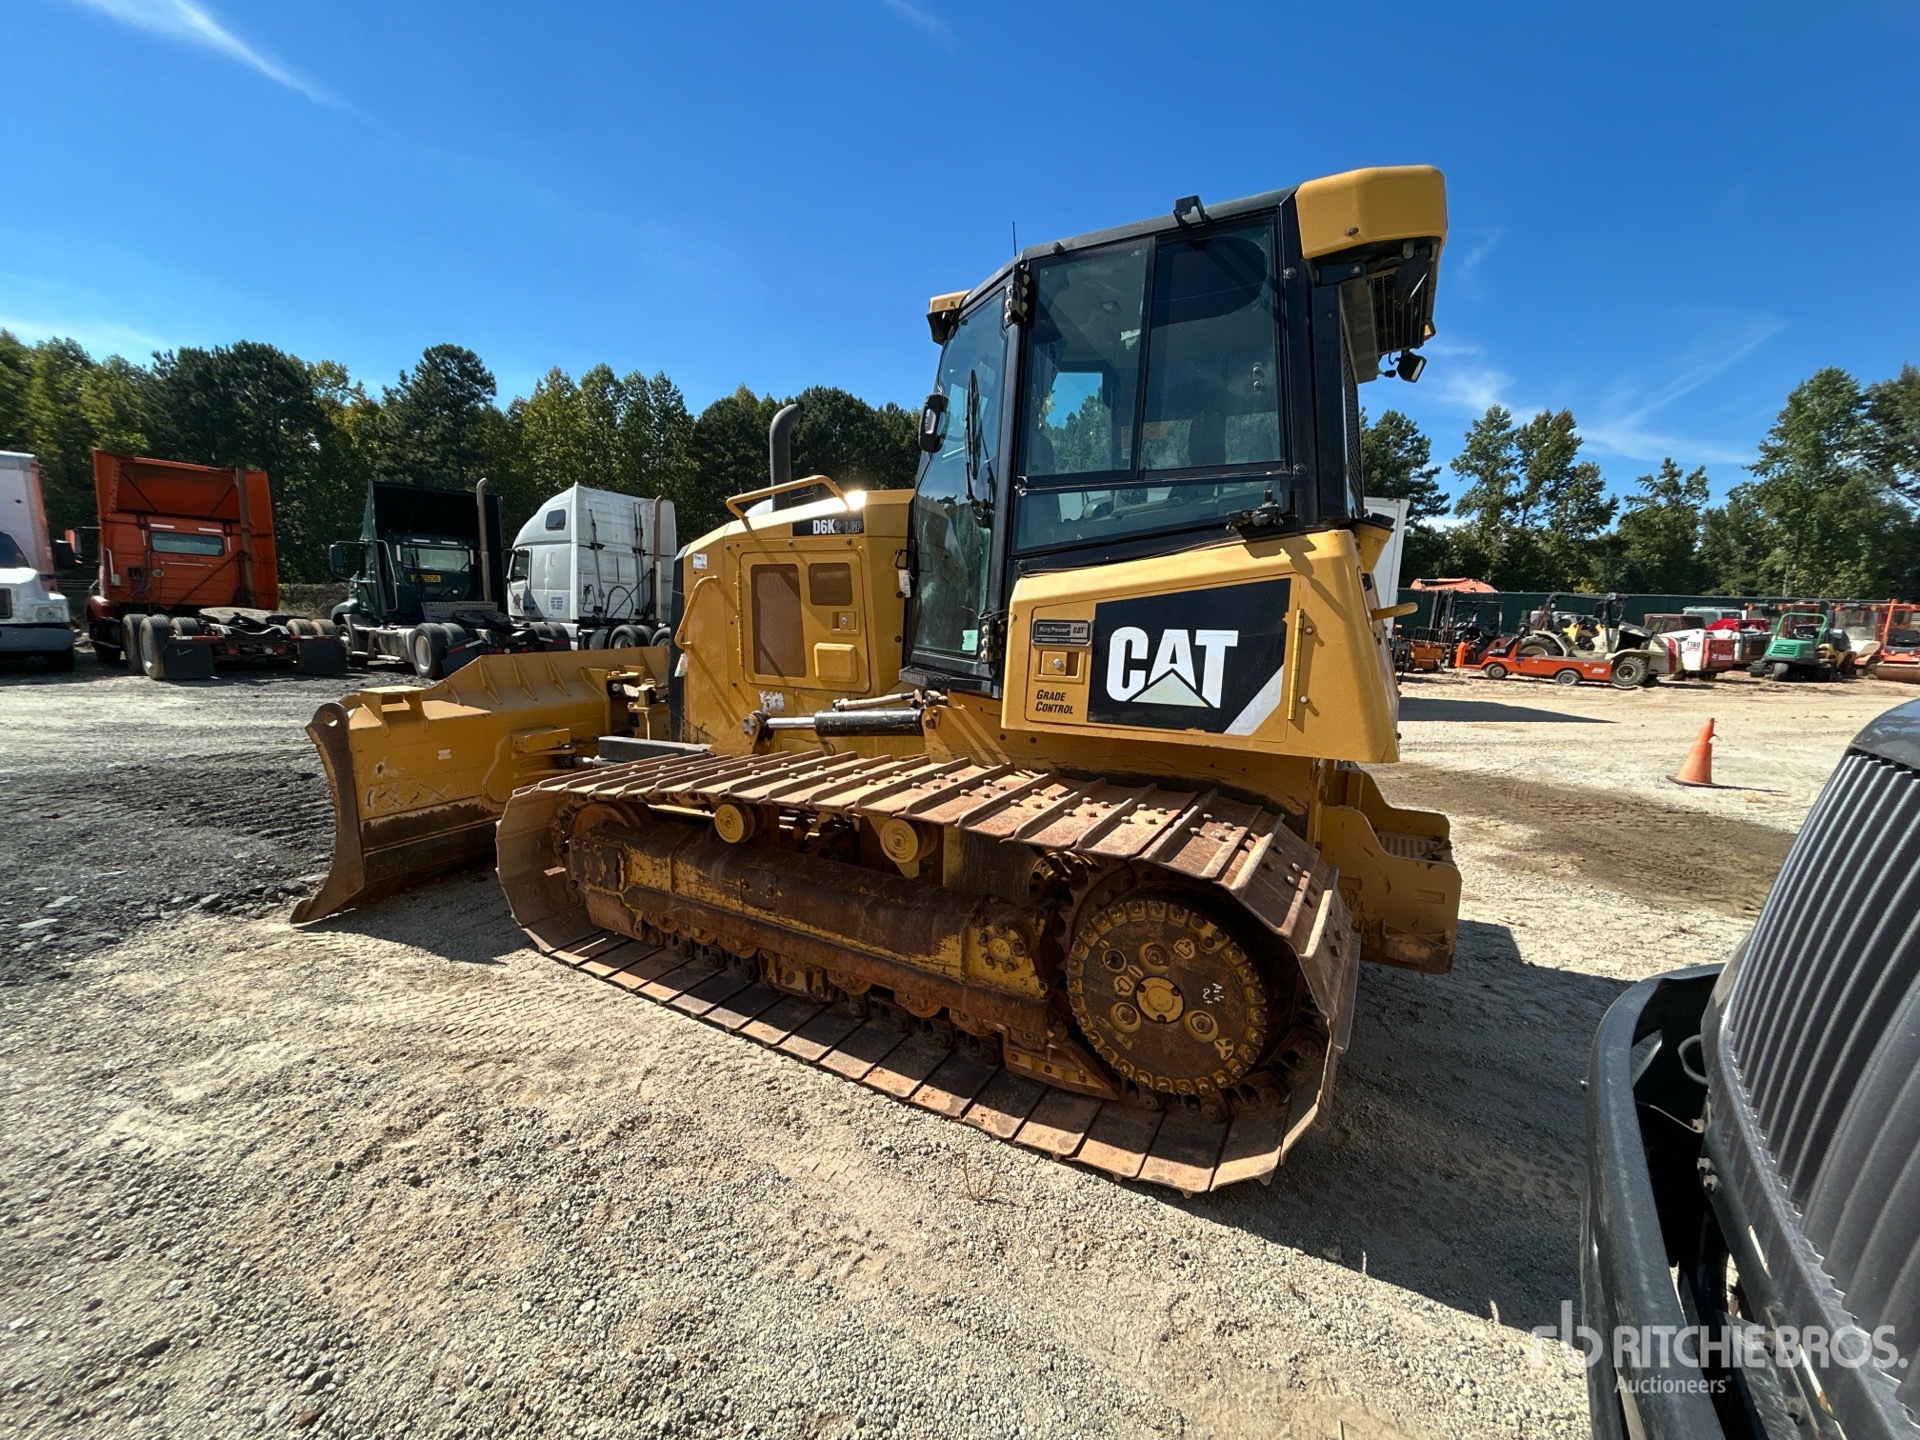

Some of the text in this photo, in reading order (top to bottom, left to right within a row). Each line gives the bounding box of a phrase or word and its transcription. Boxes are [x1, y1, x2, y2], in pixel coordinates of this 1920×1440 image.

[1072, 626, 1085, 634] CAT
[1106, 626, 1239, 709] CAT
[1036, 689, 1067, 702] GRADE
[1035, 701, 1074, 715] CONTROL
